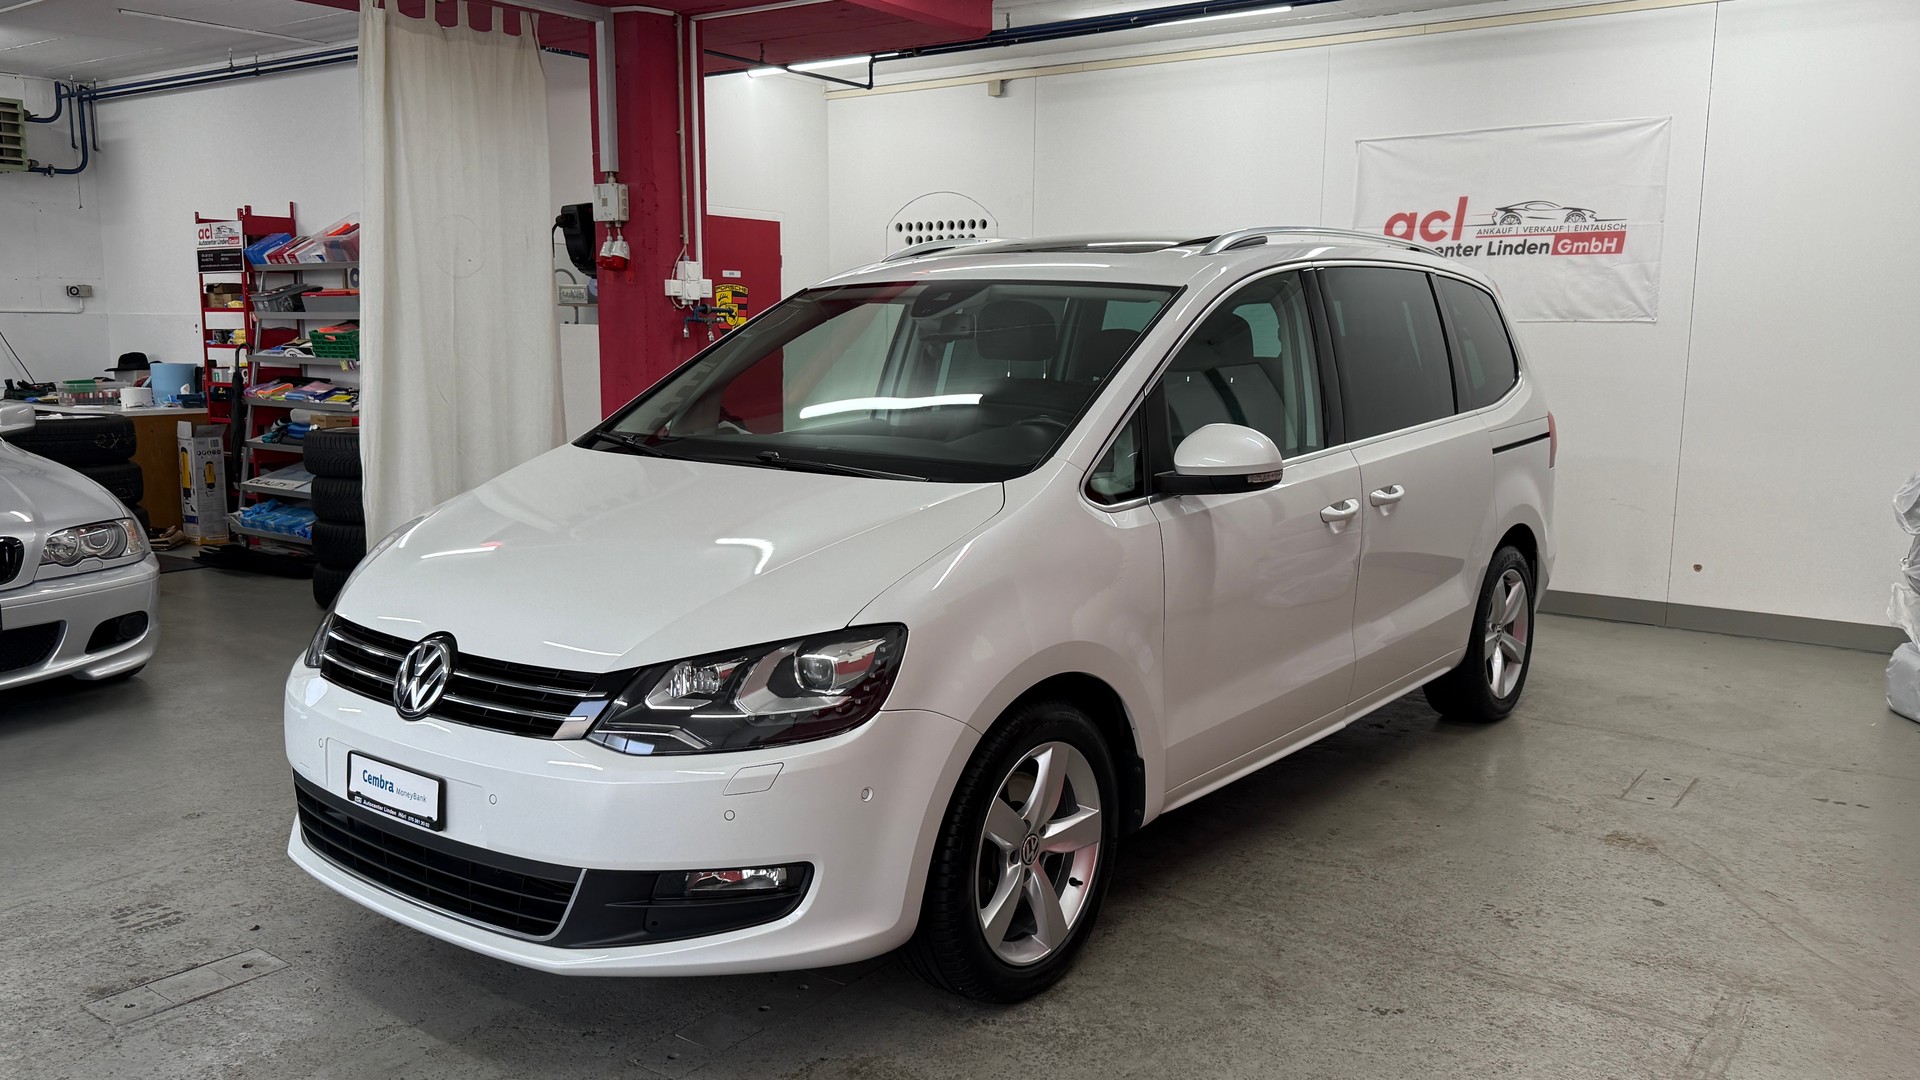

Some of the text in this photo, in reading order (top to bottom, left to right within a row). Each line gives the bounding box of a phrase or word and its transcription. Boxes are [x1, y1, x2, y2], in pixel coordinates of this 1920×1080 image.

[1384, 196, 1468, 242] acl
[198, 223, 213, 240] acl
[1477, 223, 1627, 235] ANKAUF VERKAUF EINTAUSCH
[1435, 237, 1618, 257] enter Linden GmbH
[716, 285, 748, 293] PORSCHE
[363, 769, 427, 803] Cembra MoneyBank
